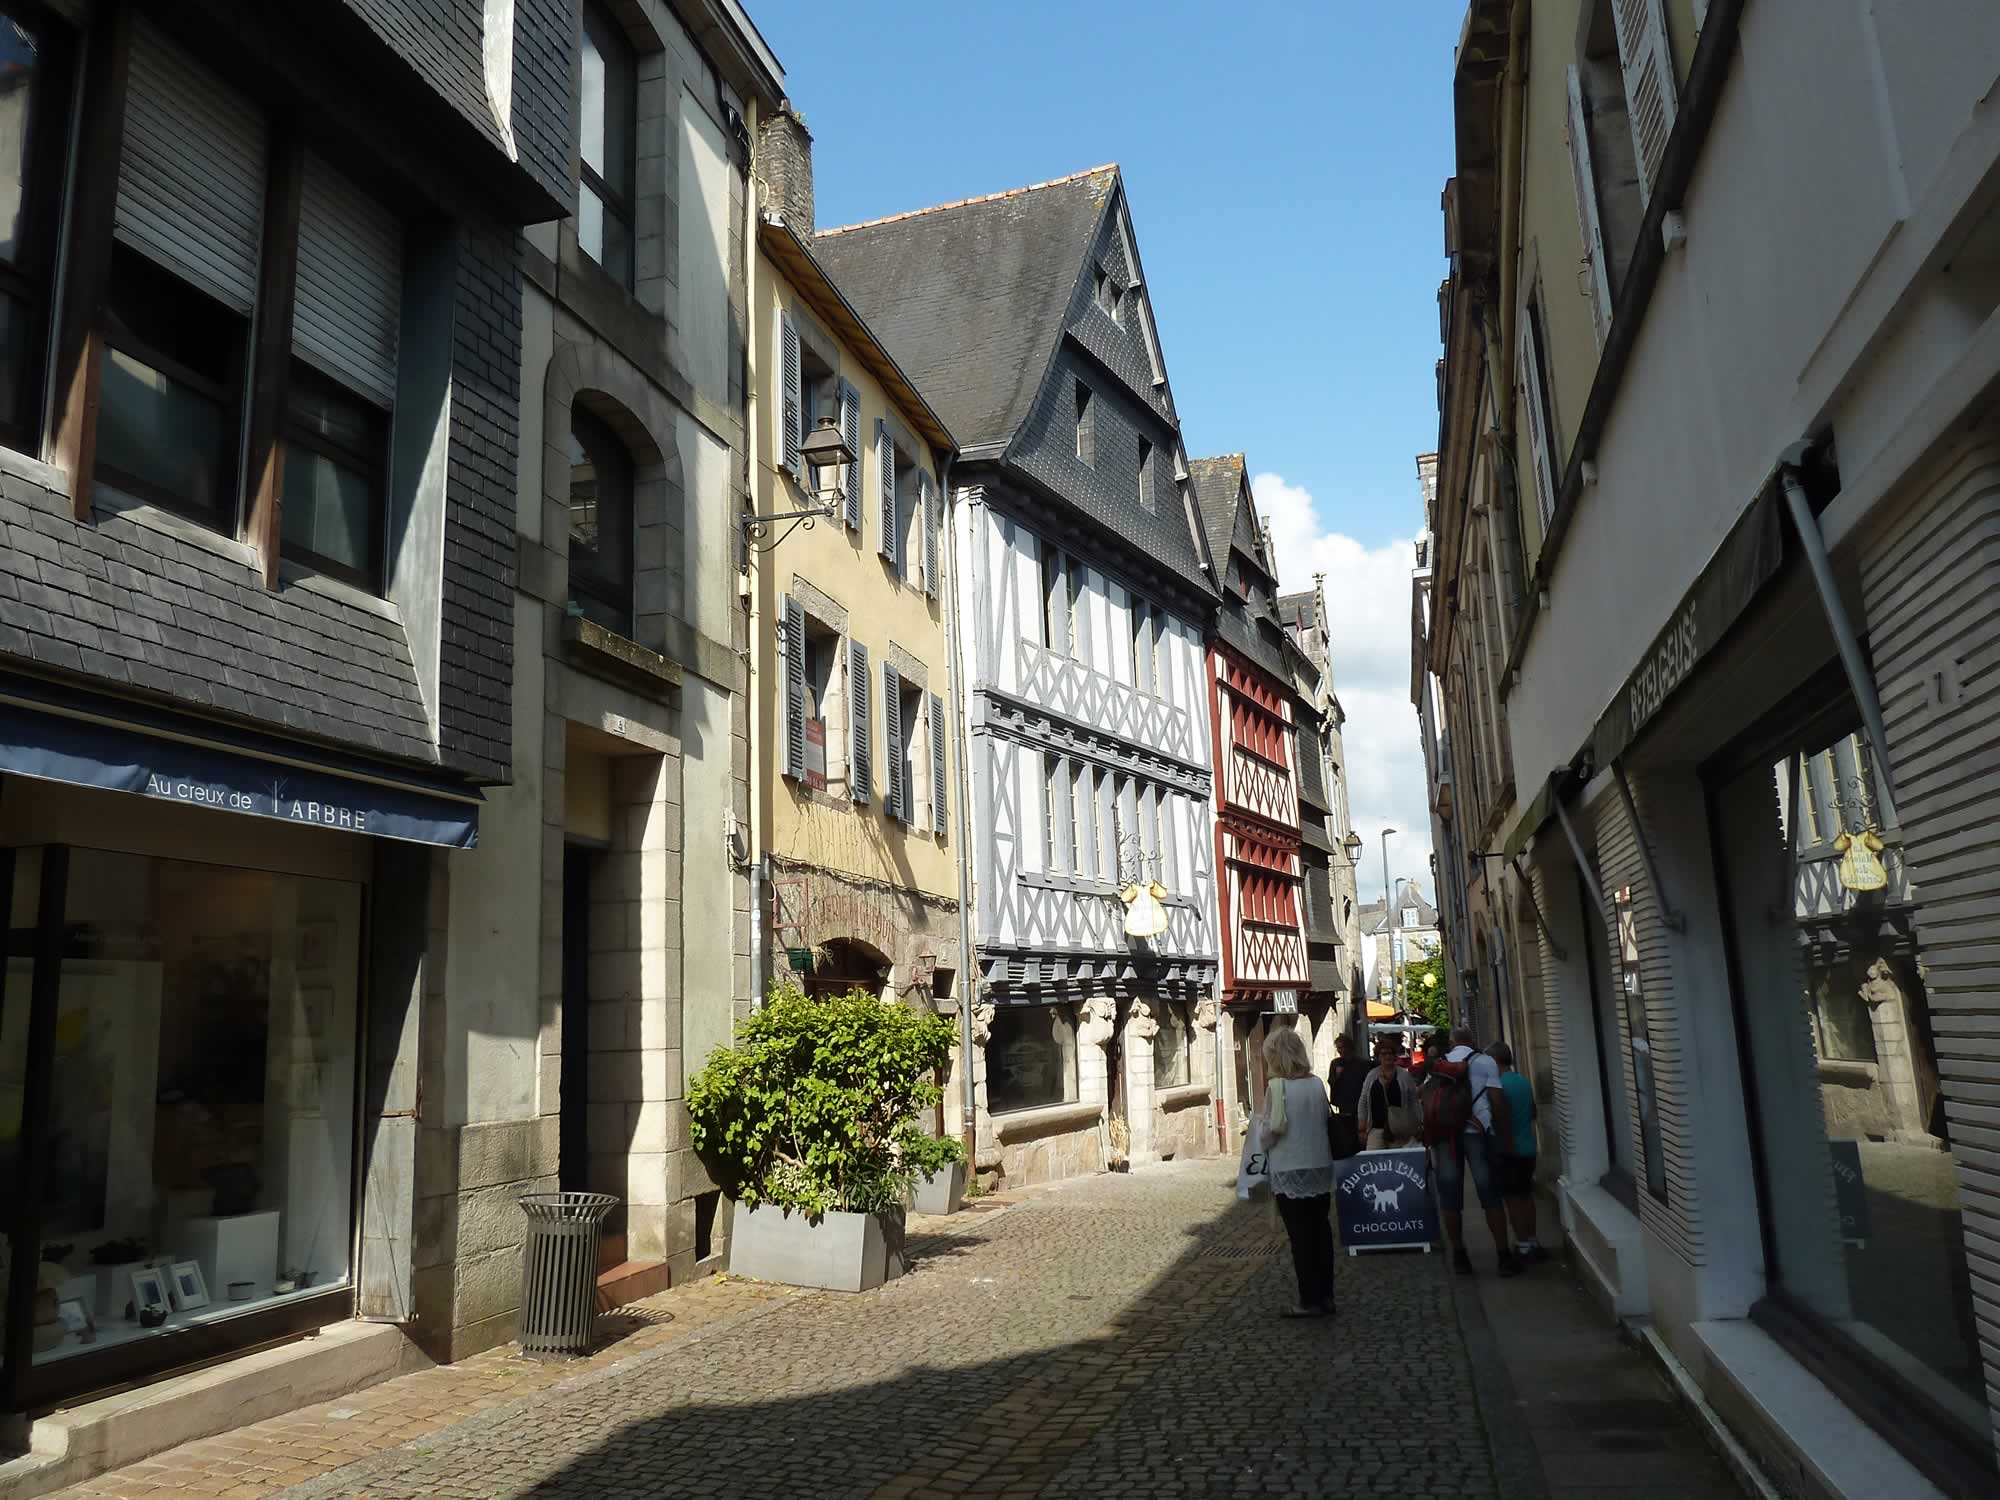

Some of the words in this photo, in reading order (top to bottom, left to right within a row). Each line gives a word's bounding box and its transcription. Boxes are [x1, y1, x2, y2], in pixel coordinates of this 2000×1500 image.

[1630, 599, 1698, 733] BETELGEUSE
[147, 773, 171, 794] Au
[177, 782, 225, 806] creux
[229, 790, 253, 810] de
[1341, 1172, 1361, 1195] Au
[1353, 1219, 1425, 1234] CHOCOLATS
